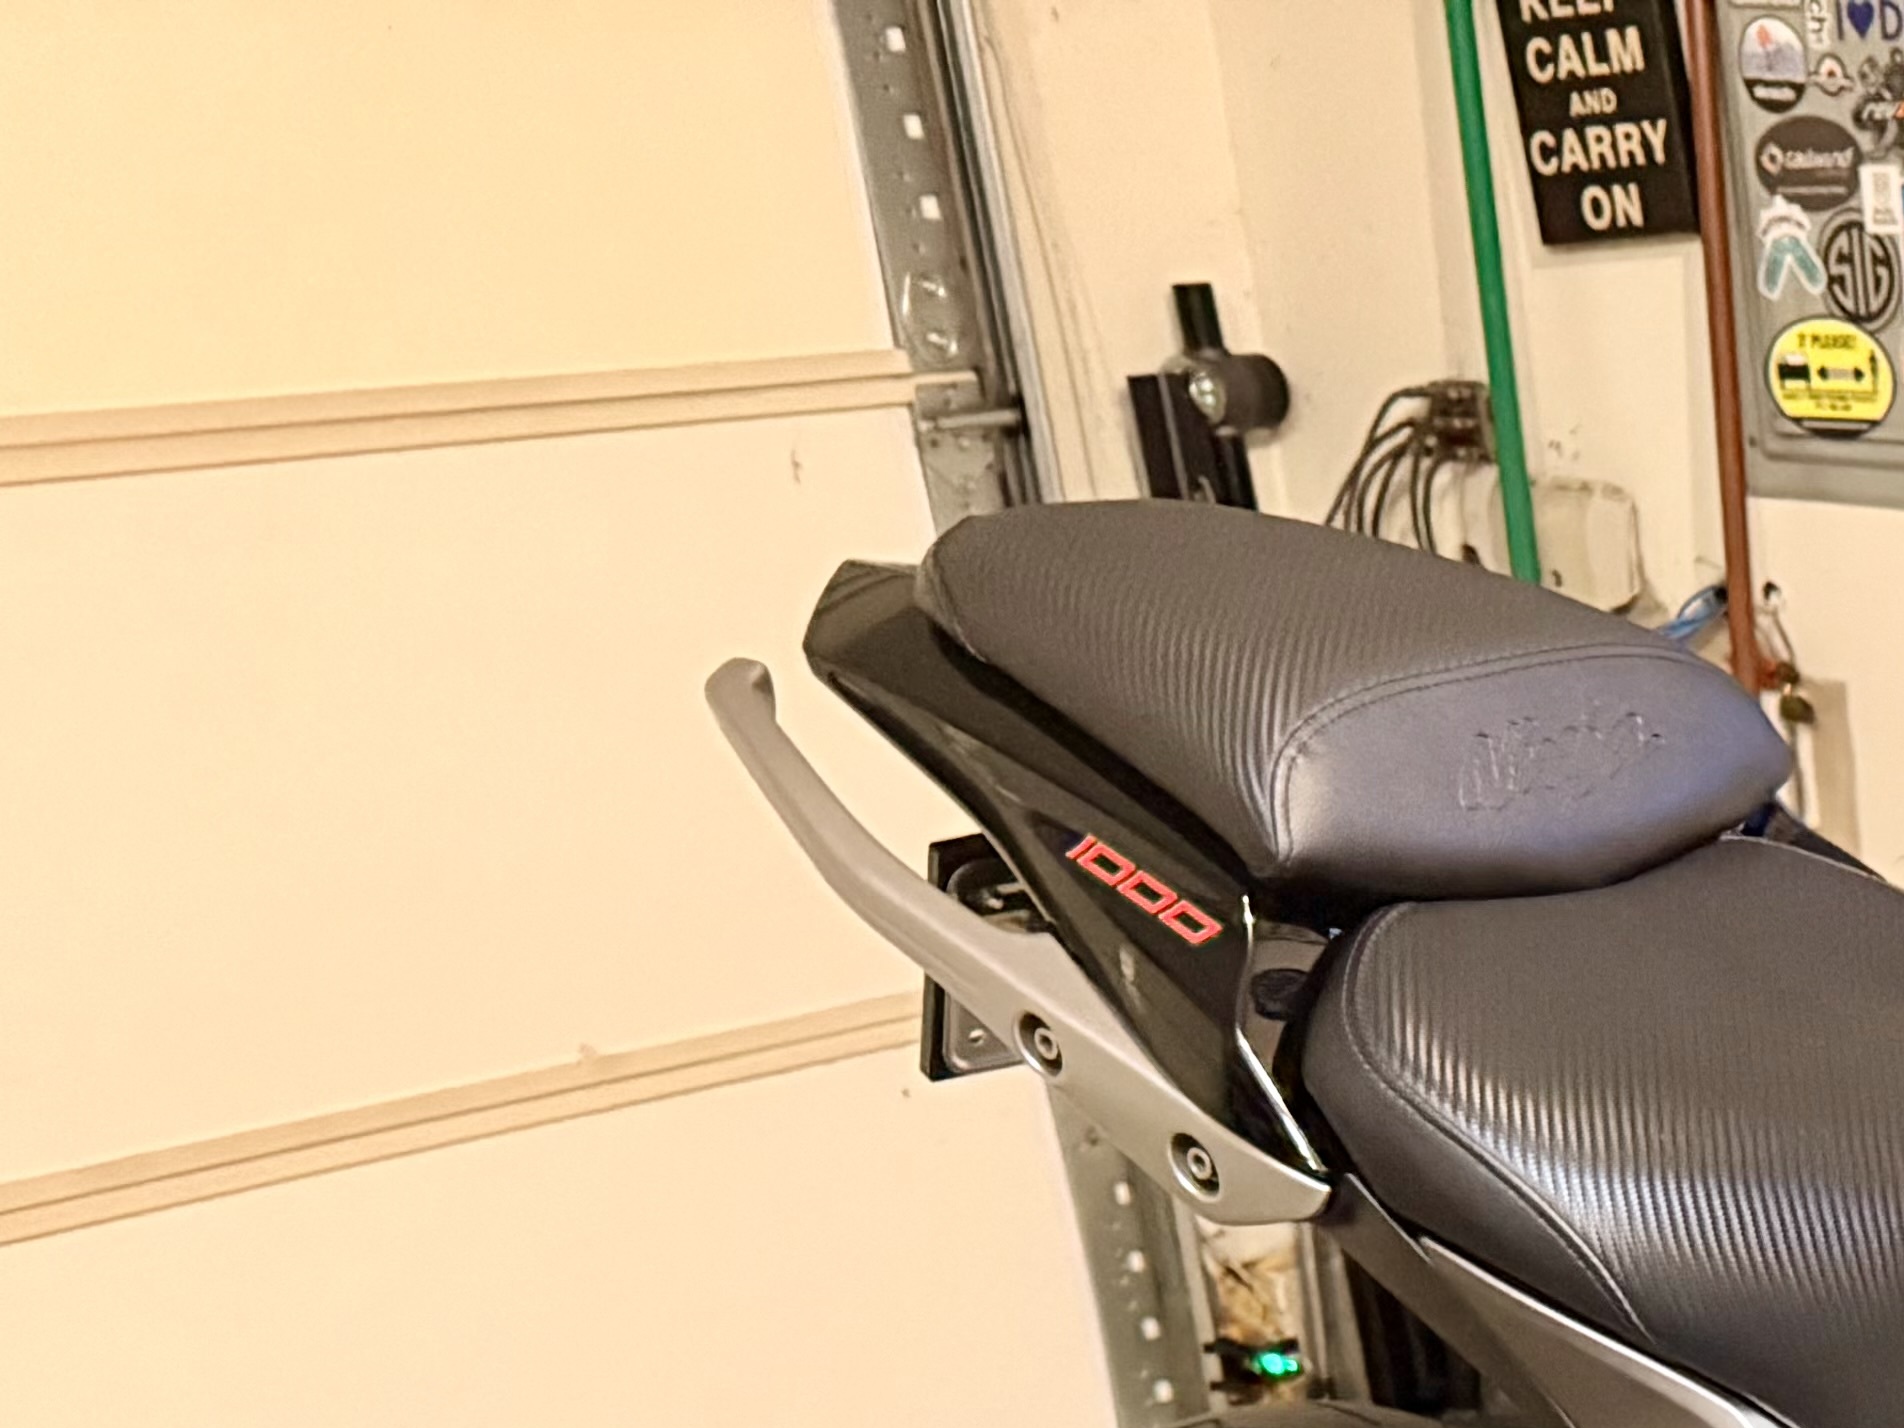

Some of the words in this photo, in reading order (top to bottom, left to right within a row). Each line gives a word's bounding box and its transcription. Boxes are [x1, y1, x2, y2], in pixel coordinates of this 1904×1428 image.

[1526, 25, 1645, 84] CALM
[1569, 88, 1618, 117] AND
[1530, 118, 1667, 176] CARRY
[1581, 182, 1644, 231] ON
[1828, 227, 1890, 316] SIG
[1066, 833, 1223, 945] 1000
